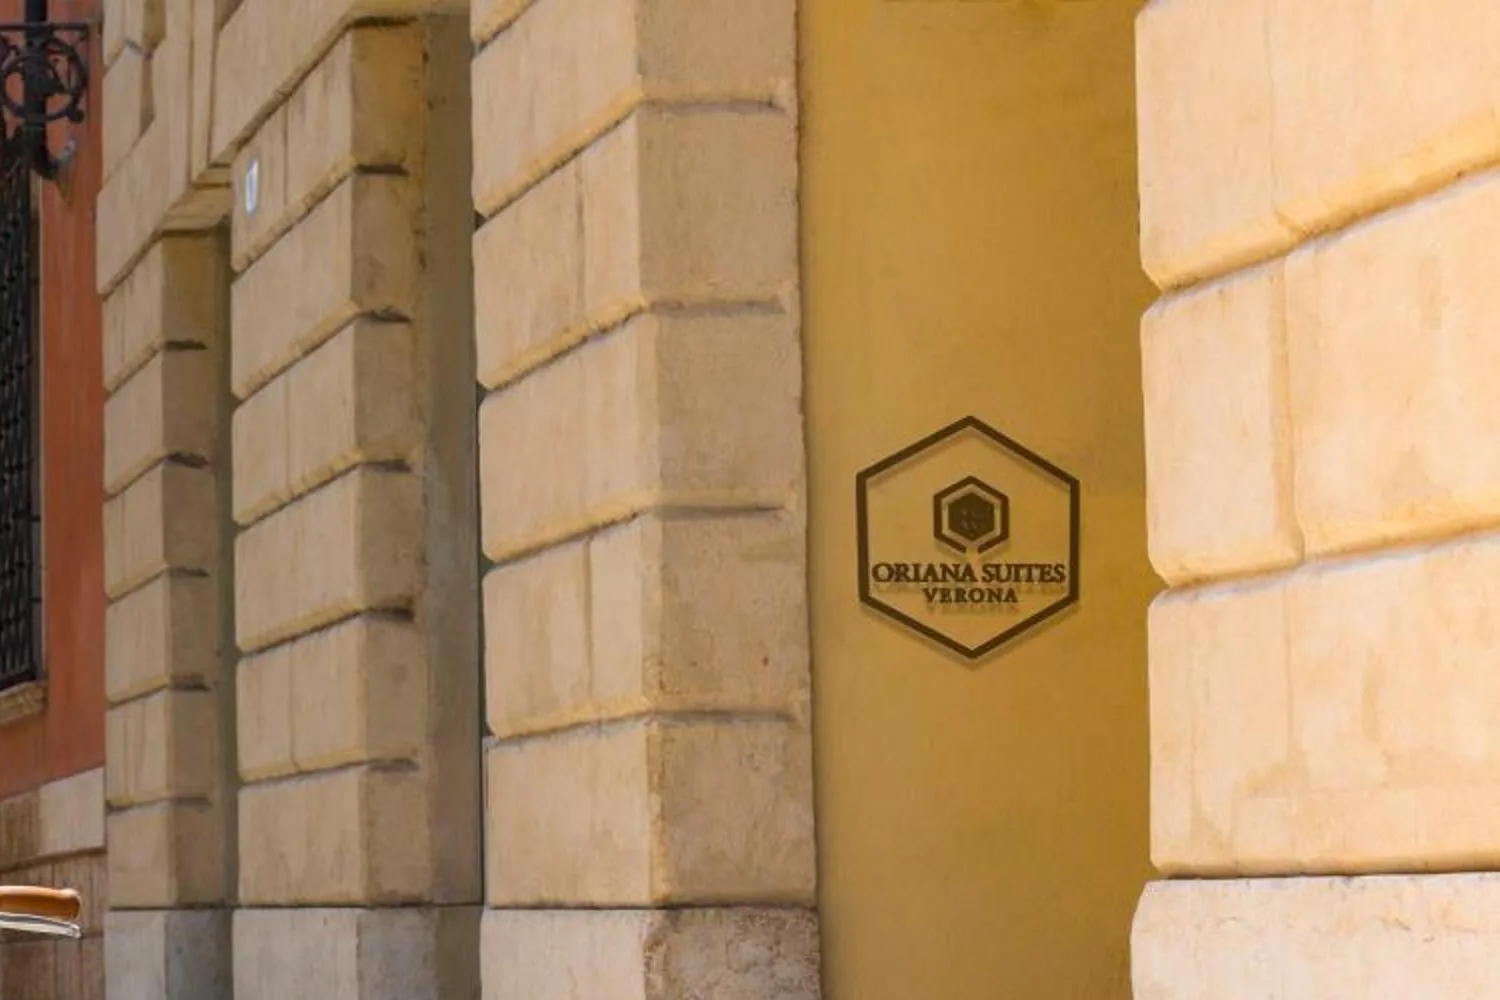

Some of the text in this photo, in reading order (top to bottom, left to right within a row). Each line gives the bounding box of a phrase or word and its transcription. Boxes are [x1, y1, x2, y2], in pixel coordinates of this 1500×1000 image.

[871, 562, 1066, 583] ORIANA SUITES
[923, 587, 1018, 603] VERONA
